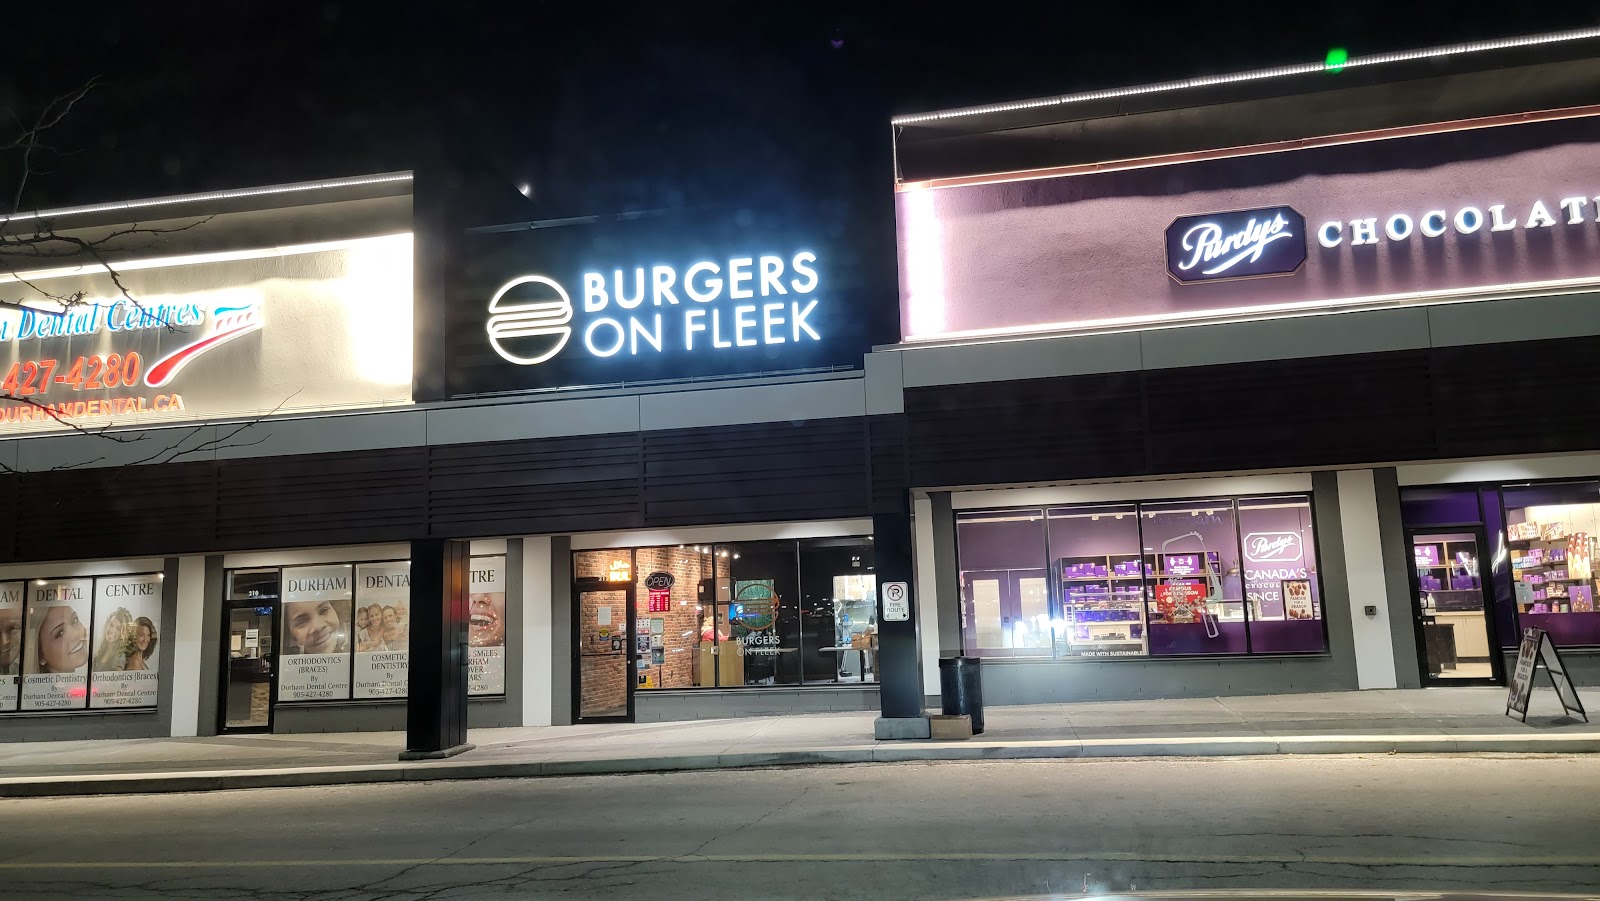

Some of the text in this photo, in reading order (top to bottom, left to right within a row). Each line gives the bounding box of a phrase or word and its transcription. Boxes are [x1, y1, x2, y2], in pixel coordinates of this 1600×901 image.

[1178, 213, 1293, 275] Purdys
[583, 251, 819, 314] BURGERS
[17, 303, 98, 338] Dental
[107, 300, 201, 331] Centres
[584, 300, 821, 357] ON FLEEK
[1250, 535, 1296, 558] Purdys
[1244, 568, 1308, 580] CANADA'S
[288, 577, 347, 593] DURHAM
[646, 576, 672, 587] OPEN
[36, 588, 83, 602] DENTAL
[105, 583, 154, 597] CENTRE
[1247, 592, 1280, 602] SINCE
[736, 635, 781, 646] BURGERS
[371, 653, 407, 661] COSMETIC
[736, 646, 781, 657] ON FLEEK
[287, 656, 342, 666] ORTHODONTICS
[371, 662, 409, 670] DENTISTRY
[298, 665, 328, 674] (BRACES)
[23, 674, 87, 685] Cosmetic Dentistry
[92, 672, 133, 683] Orthodontics
[310, 675, 319, 683] By
[386, 672, 394, 680] By
[120, 682, 129, 690] By
[327, 682, 349, 690] Centre
[116, 689, 136, 697] Dental
[136, 688, 157, 697] Centre
[292, 690, 334, 698] 905-427-4280
